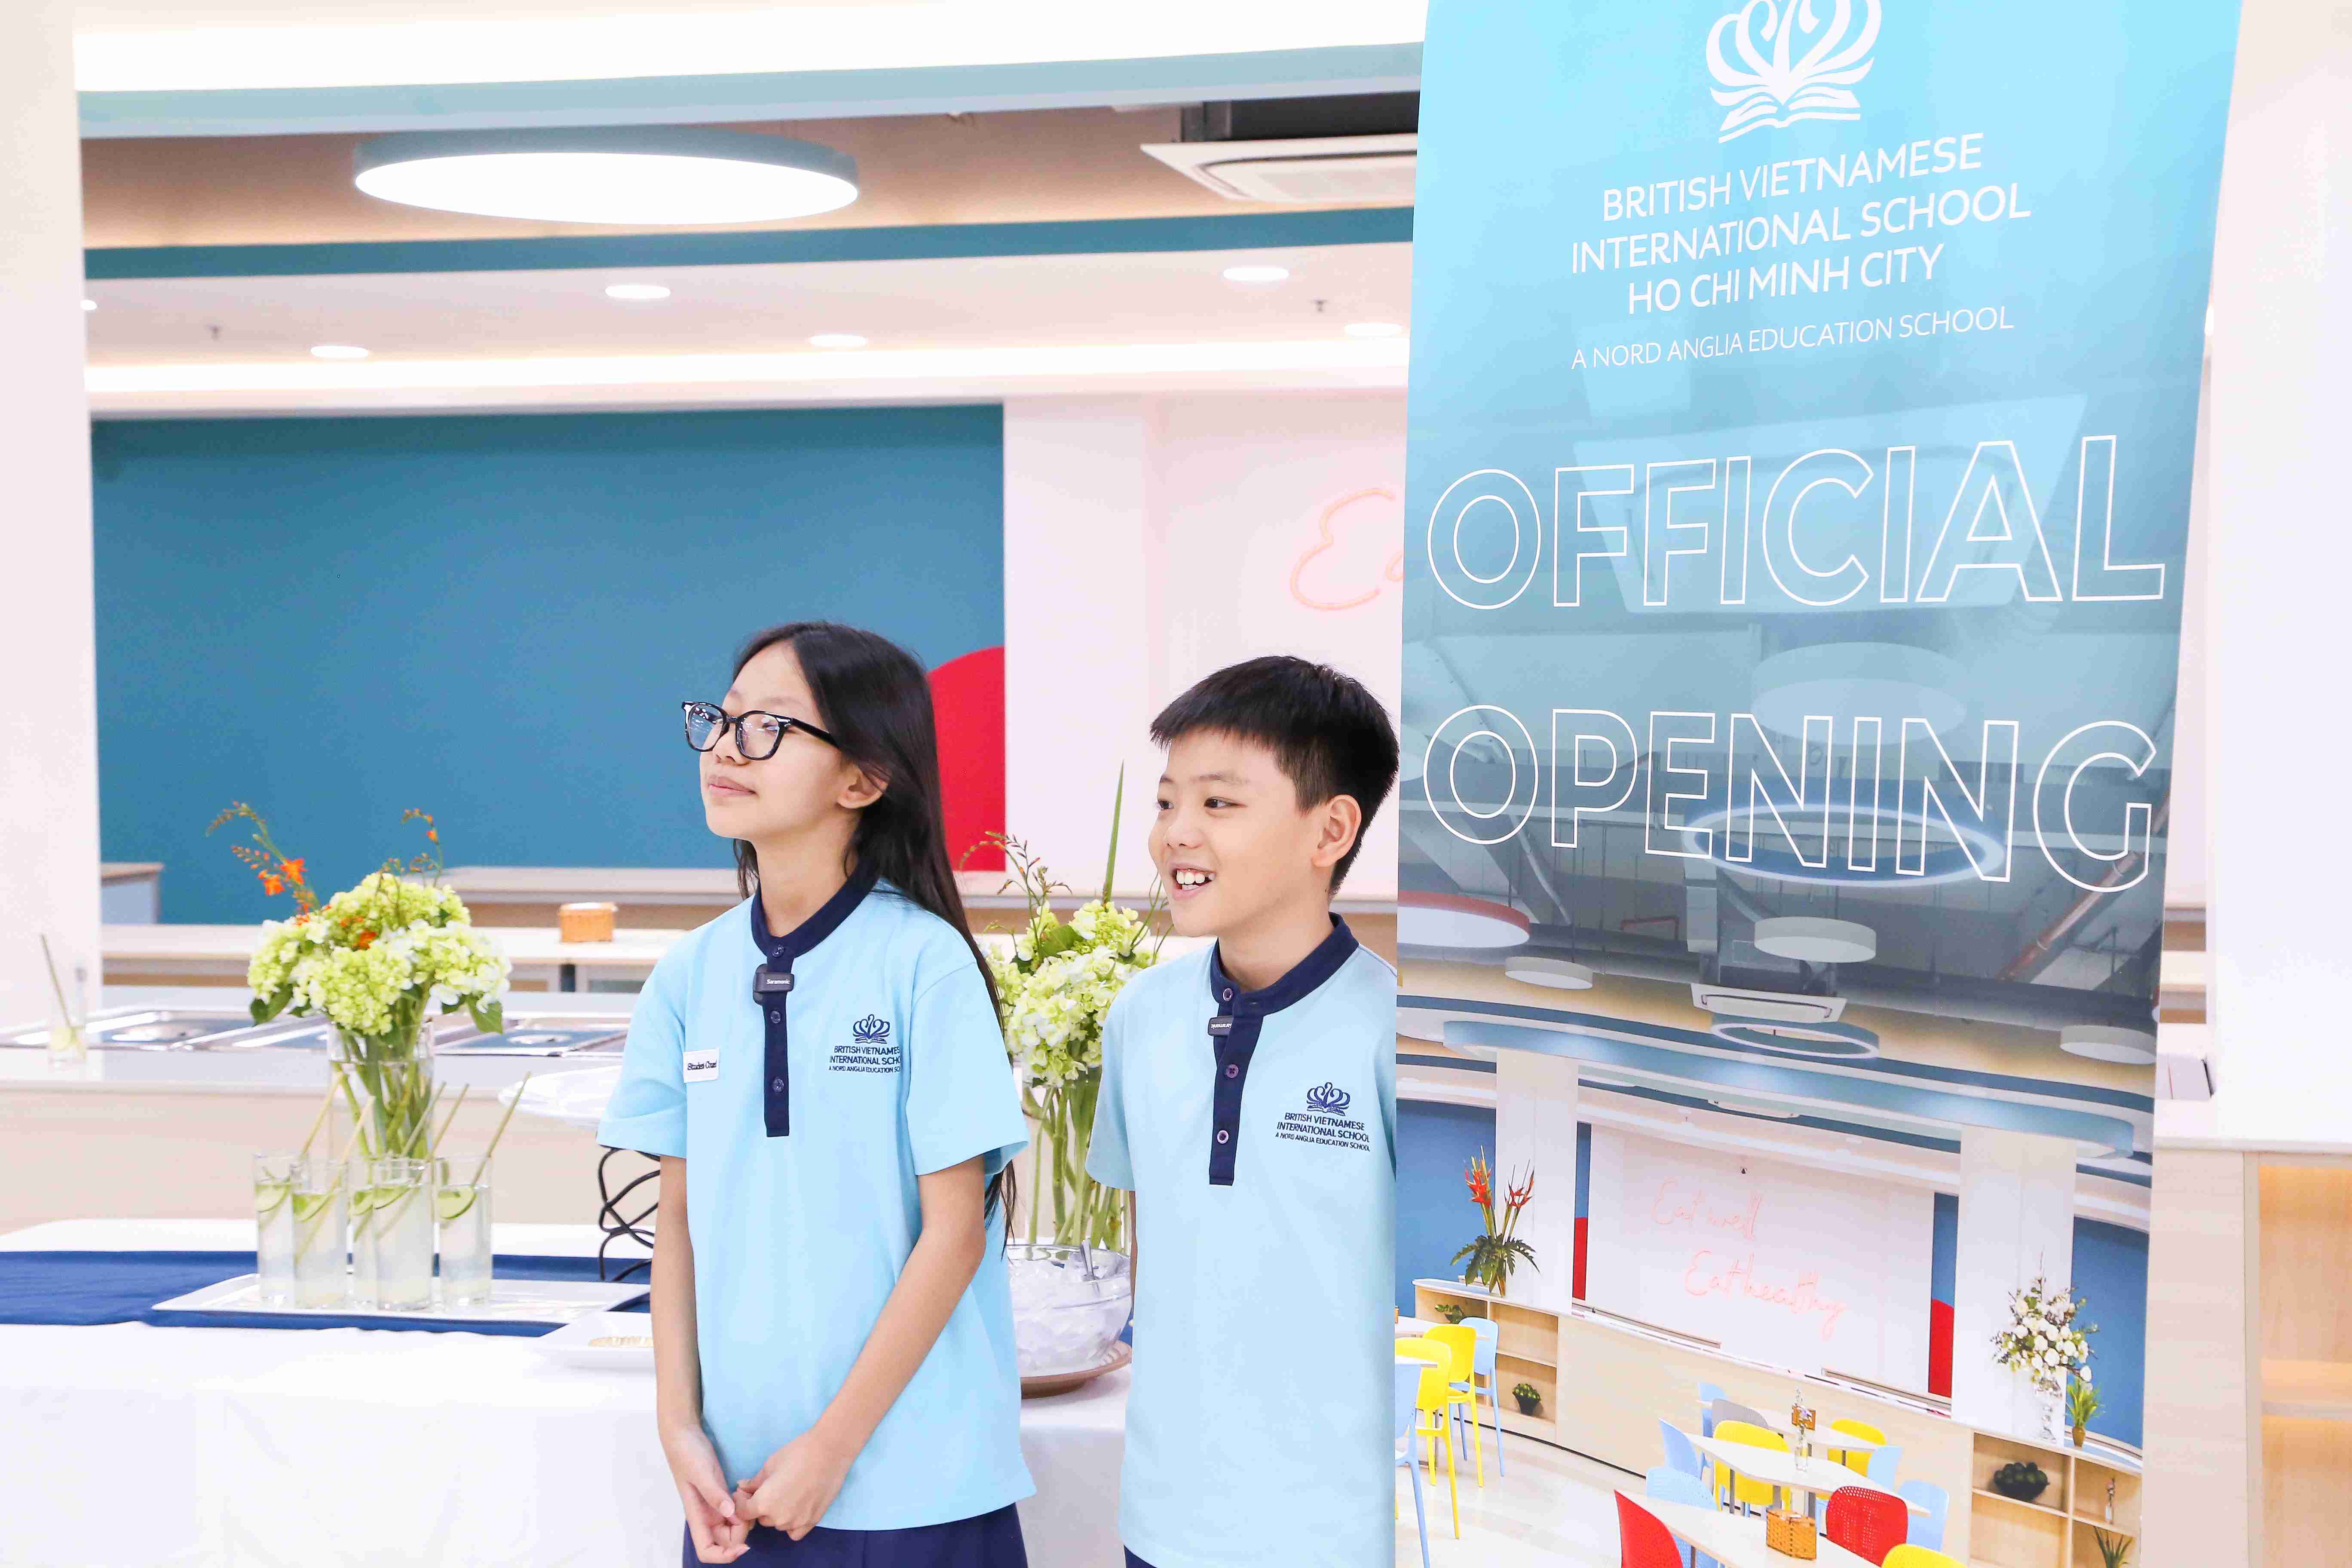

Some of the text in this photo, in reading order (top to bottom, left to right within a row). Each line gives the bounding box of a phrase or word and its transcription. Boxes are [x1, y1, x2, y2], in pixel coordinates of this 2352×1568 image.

[1603, 132, 1984, 222] BRITISH VIETNAMESE
[1572, 182, 2032, 274] INTERNATIONAL SCHOOL
[1629, 243, 1945, 315] HO CHI MINH CITY
[1571, 305, 2015, 370] A NORD ANGLIA EDUCATION SCHOOL
[1427, 434, 2165, 610] OFFICIAL
[1423, 704, 2157, 893] OPENING
[834, 1045, 900, 1055] BRITISH VIETNAMES
[1277, 1121, 1370, 1142] INTERNATIONAL SCHOOL
[1284, 1112, 1365, 1131] BRITISH VIETNAMESE
[1295, 1134, 1314, 1143] ANGLIA
[1316, 1137, 1349, 1148] EDUCATION
[1349, 1142, 1370, 1152] SCHOOL
[1655, 1179, 1761, 1242] Eat well
